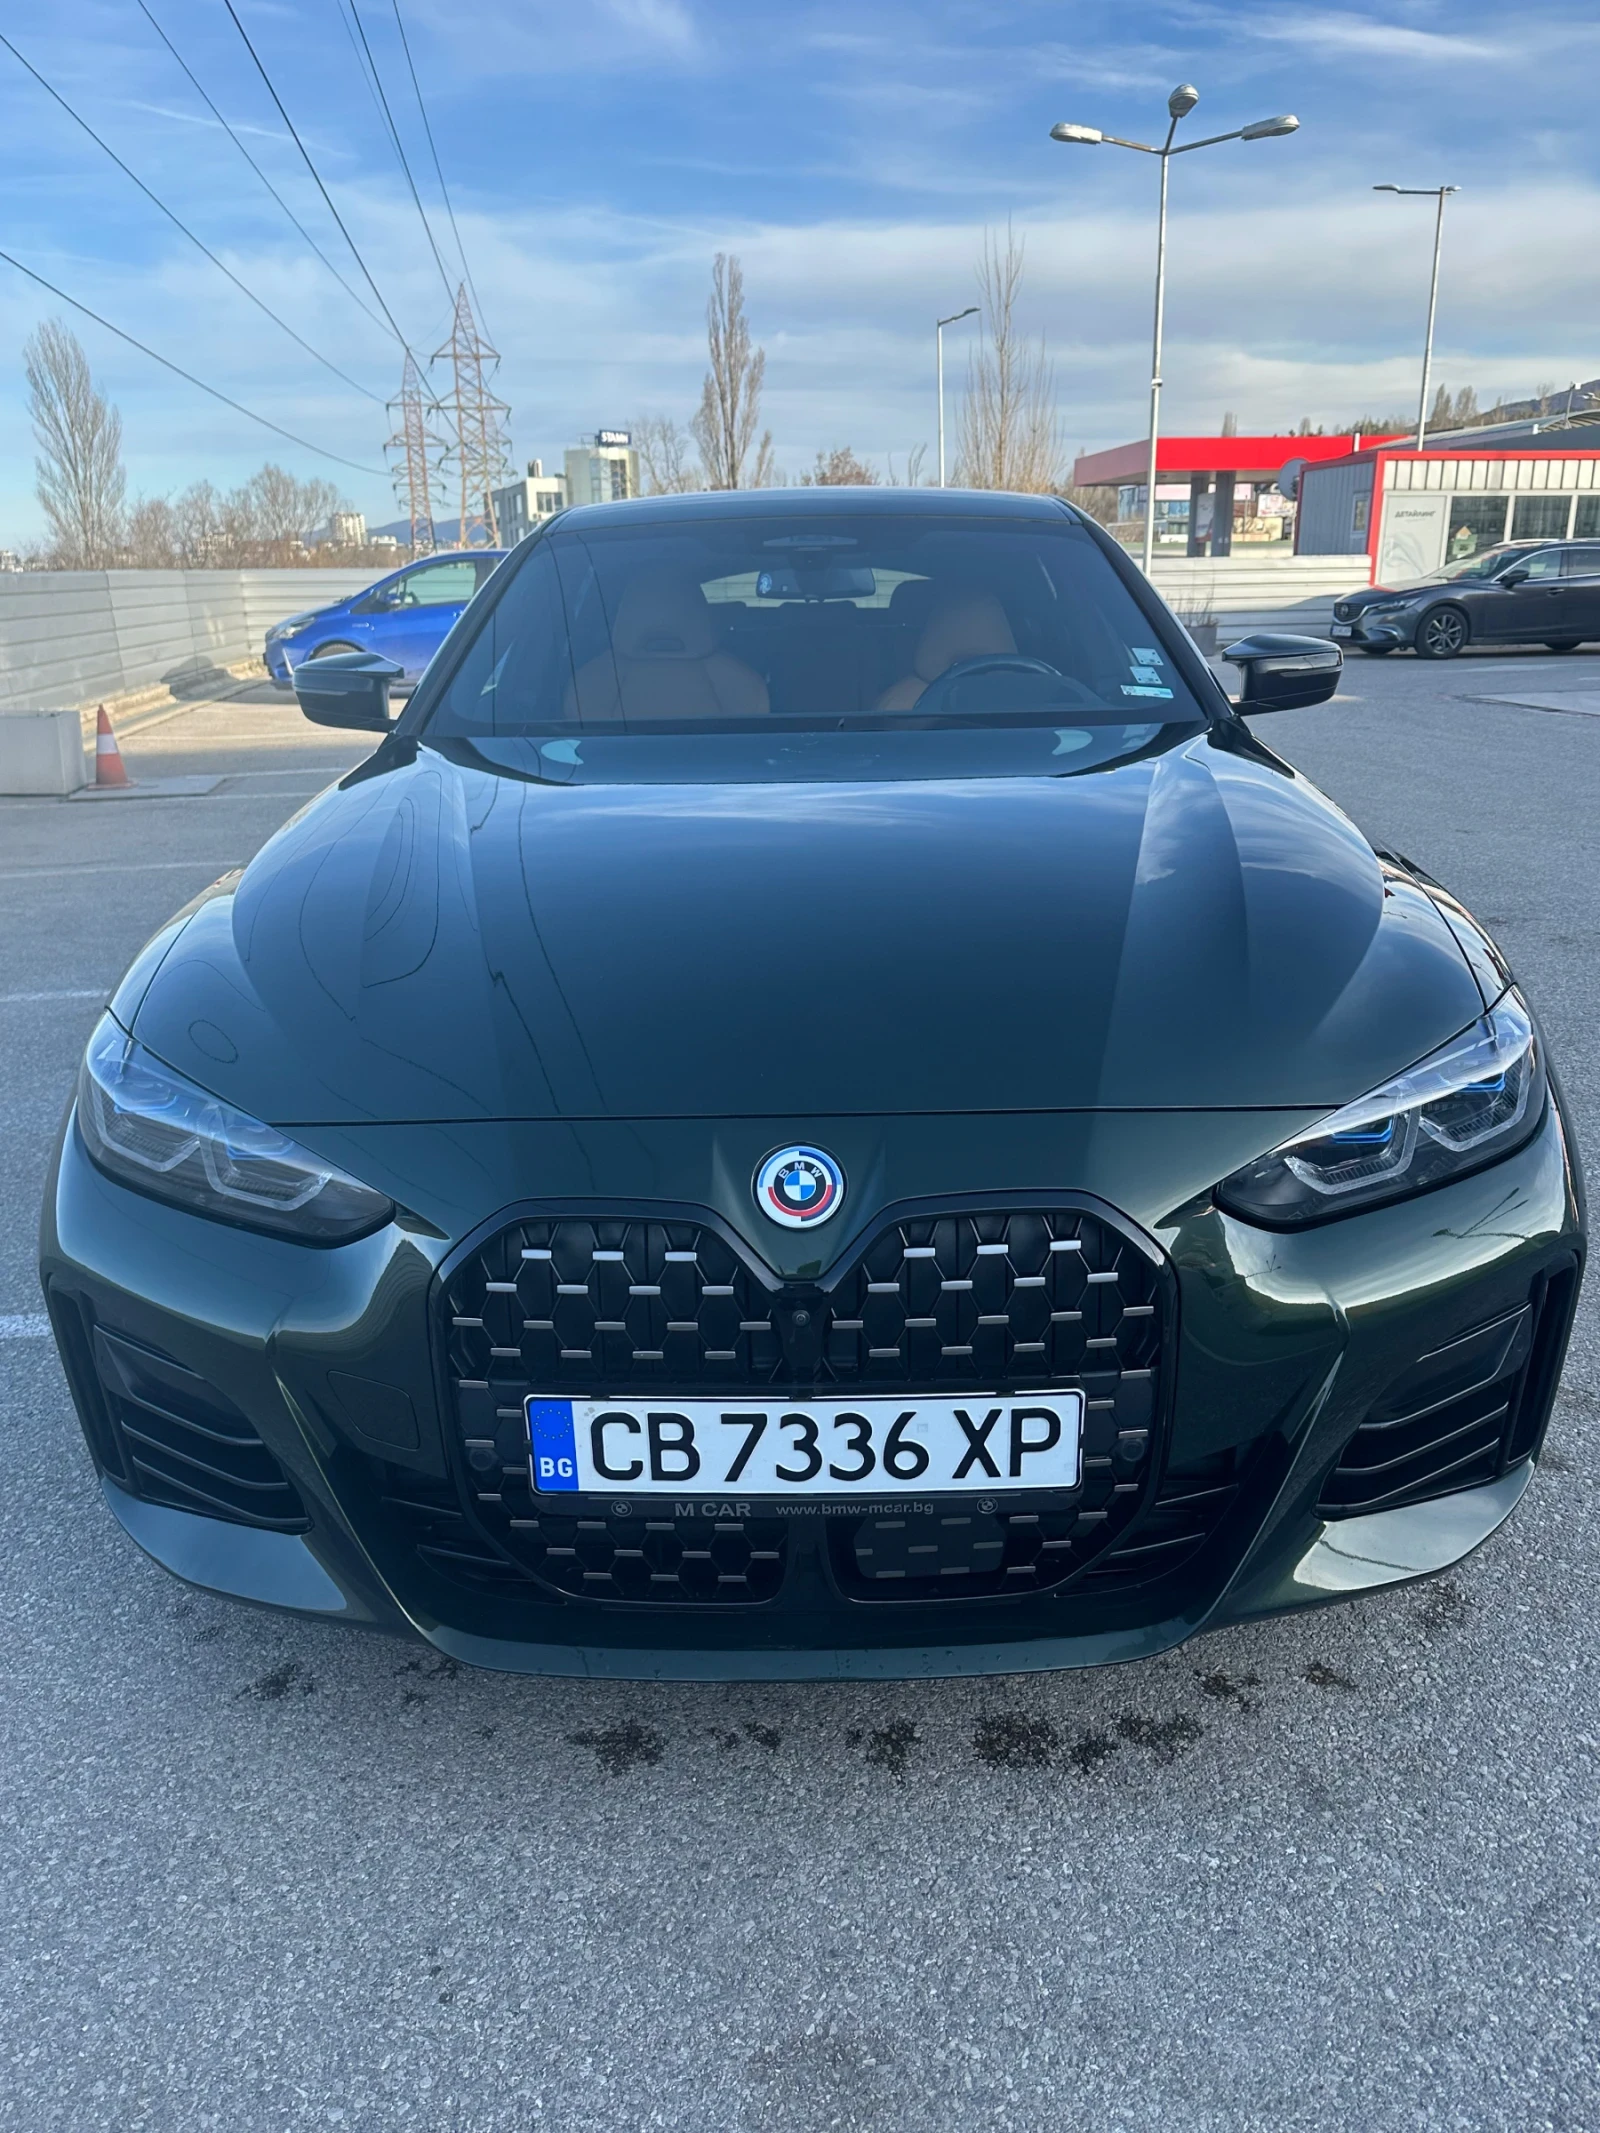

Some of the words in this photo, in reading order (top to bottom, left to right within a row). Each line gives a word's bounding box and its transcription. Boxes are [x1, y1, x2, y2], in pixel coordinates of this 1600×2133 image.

[778, 1161, 823, 1179] BMW
[590, 1411, 700, 1481] CB
[719, 1411, 930, 1482] 7336
[951, 1407, 1062, 1480] XP
[540, 1457, 573, 1478] BG
[674, 1503, 695, 1517] M
[701, 1502, 752, 1517] CAR
[775, 1502, 934, 1515] www.bmw-mcar.bg
